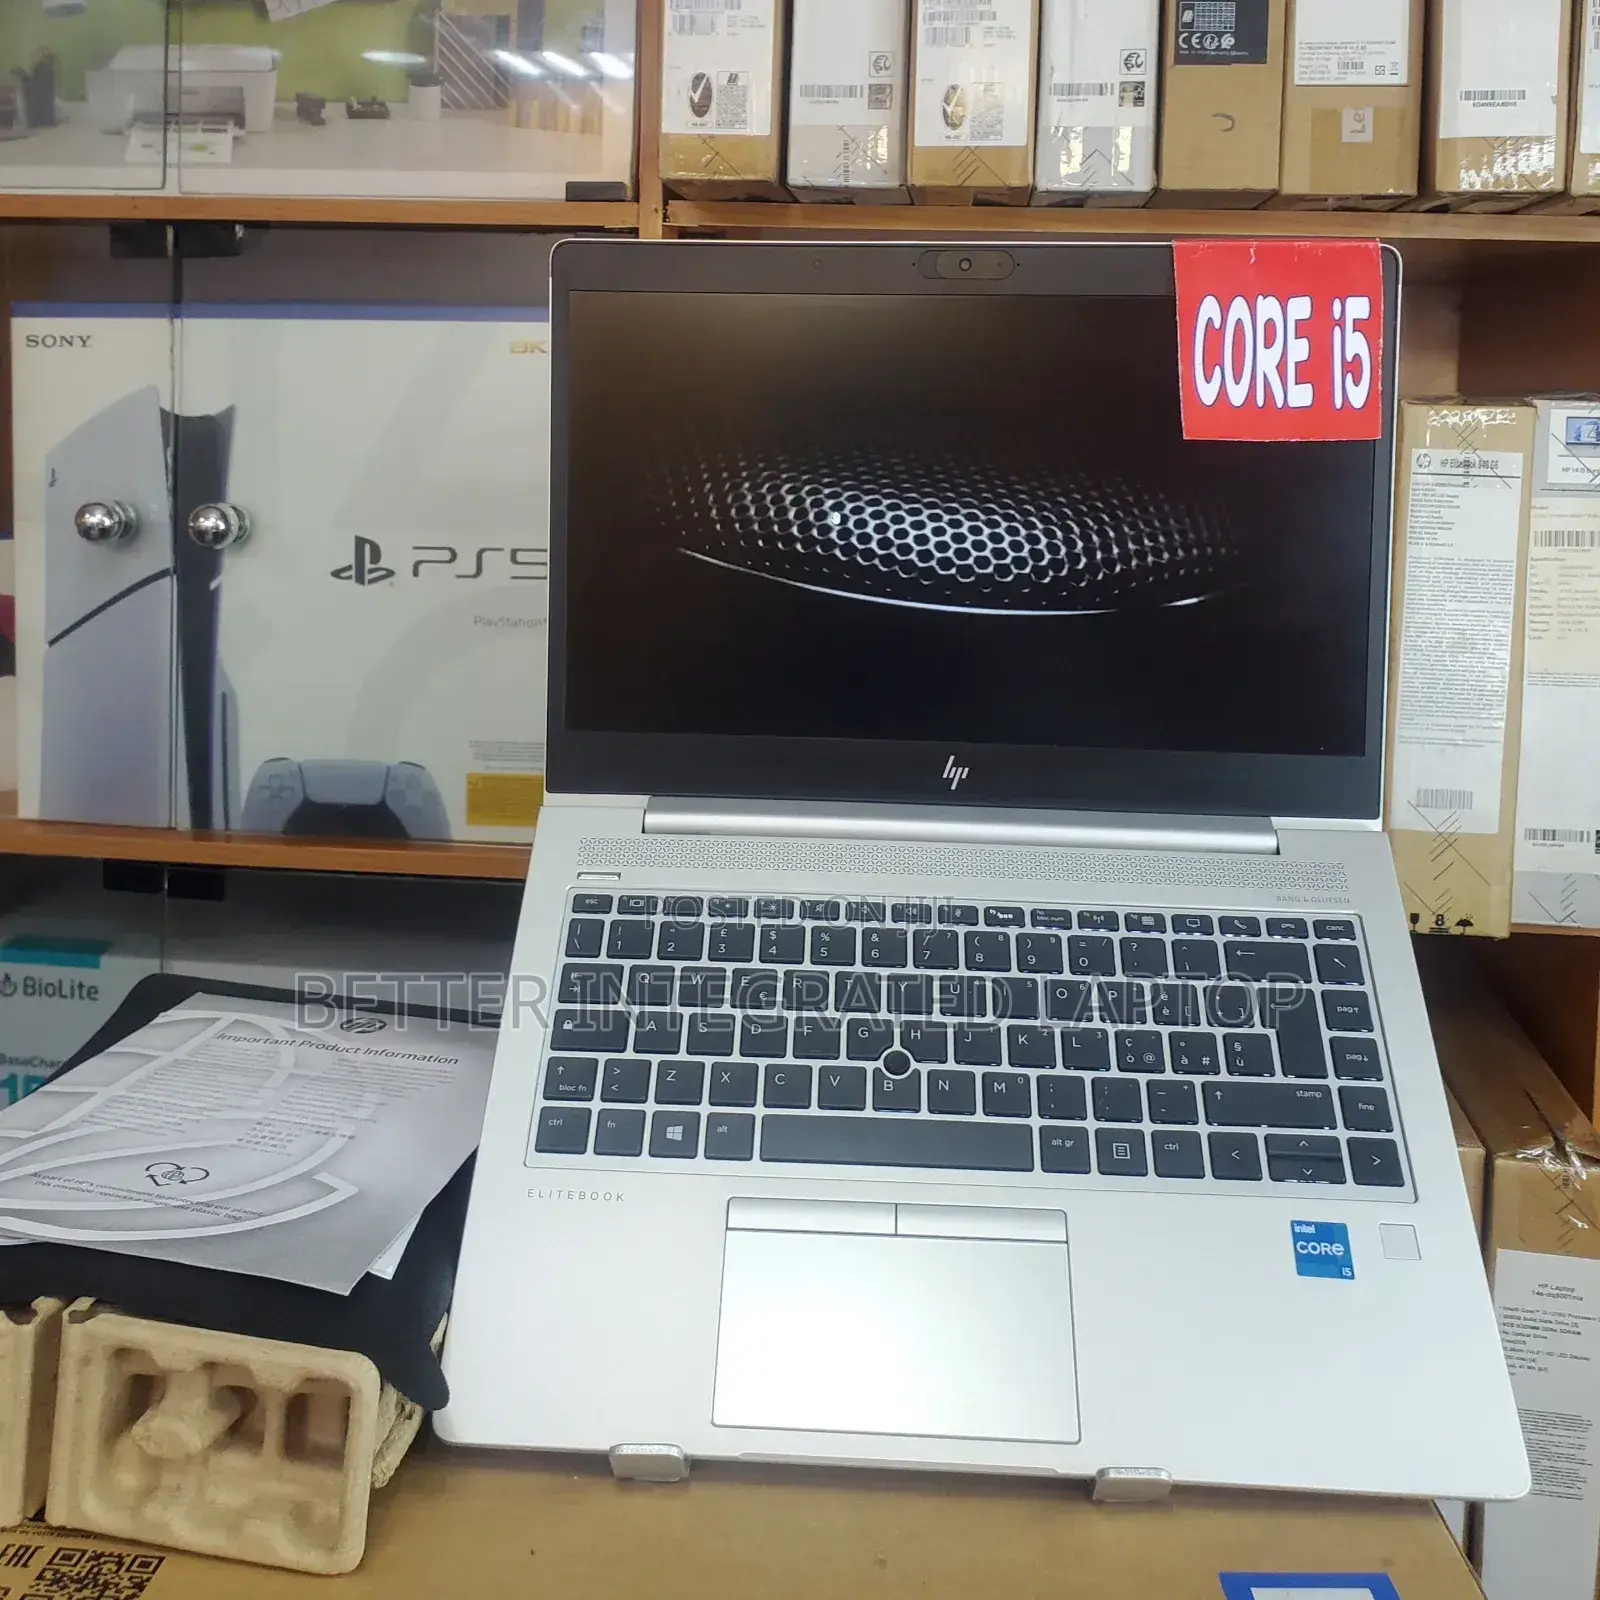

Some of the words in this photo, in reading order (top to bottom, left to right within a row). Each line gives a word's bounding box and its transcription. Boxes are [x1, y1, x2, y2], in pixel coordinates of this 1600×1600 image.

[25, 335, 92, 348] SONY
[1193, 294, 1314, 410] CORE
[1332, 295, 1371, 411] i5
[1435, 913, 1445, 927] 8
[1325, 924, 1346, 932] canc
[769, 930, 777, 940] $
[820, 932, 831, 942] %
[871, 932, 880, 942] &
[616, 941, 622, 950] 1
[667, 942, 675, 952] 2
[718, 944, 726, 953] 3
[768, 945, 778, 955] 4
[820, 947, 828, 957] 5
[871, 948, 879, 959] 6
[923, 950, 930, 960] 7
[975, 952, 984, 963] 8
[1027, 954, 1036, 965] 9
[639, 973, 650, 984] Q
[690, 975, 706, 986] W
[741, 977, 750, 987] E
[793, 978, 803, 988] R
[22, 975, 99, 1002] BioLite
[844, 980, 853, 990] T
[899, 982, 908, 993] Y
[950, 984, 961, 995] U
[758, 991, 768, 1000] €
[1056, 988, 1067, 999] O
[1108, 991, 1118, 1001] P
[1162, 1006, 1170, 1016] è
[646, 1021, 657, 1031] A
[699, 1022, 709, 1033] S
[751, 1024, 762, 1035] D
[803, 1026, 813, 1036] F
[858, 1028, 869, 1038] G
[911, 1029, 921, 1040] H
[964, 1032, 972, 1043] J
[1018, 1034, 1028, 1045] K
[1072, 1037, 1082, 1047] L
[1125, 1038, 1133, 1048] ç
[216, 1033, 298, 1047] Important
[299, 1040, 361, 1055] Product
[363, 1047, 460, 1065] Information
[1126, 1052, 1135, 1063] ò
[1143, 1052, 1156, 1064] @
[1180, 1054, 1189, 1065] à
[1201, 1055, 1211, 1065] #
[1236, 1056, 1244, 1067] ù
[666, 1070, 677, 1081] Z
[720, 1072, 731, 1083] X
[774, 1073, 786, 1085] C
[829, 1075, 841, 1086] V
[558, 1084, 576, 1092] bloc
[578, 1084, 587, 1092] fn
[884, 1080, 894, 1091] B
[938, 1080, 949, 1091] N
[994, 1082, 1006, 1093] M
[1296, 1089, 1322, 1099] stamp
[1358, 1102, 1375, 1111] fine
[548, 1118, 563, 1126] ctrl
[607, 1120, 616, 1129] fn
[716, 1125, 728, 1133] alt
[1051, 1138, 1063, 1146] alt
[1064, 1139, 1074, 1147] gr
[1164, 1142, 1179, 1151] ctrl
[95, 1184, 154, 1196] commitment
[527, 1188, 625, 1202] ELITEBOOK
[52, 1184, 95, 1194] envelope
[95, 1190, 134, 1201] replaces
[190, 1206, 222, 1217] plastic
[1293, 1223, 1316, 1234] intel
[1550, 1285, 1576, 1293] Laptop
